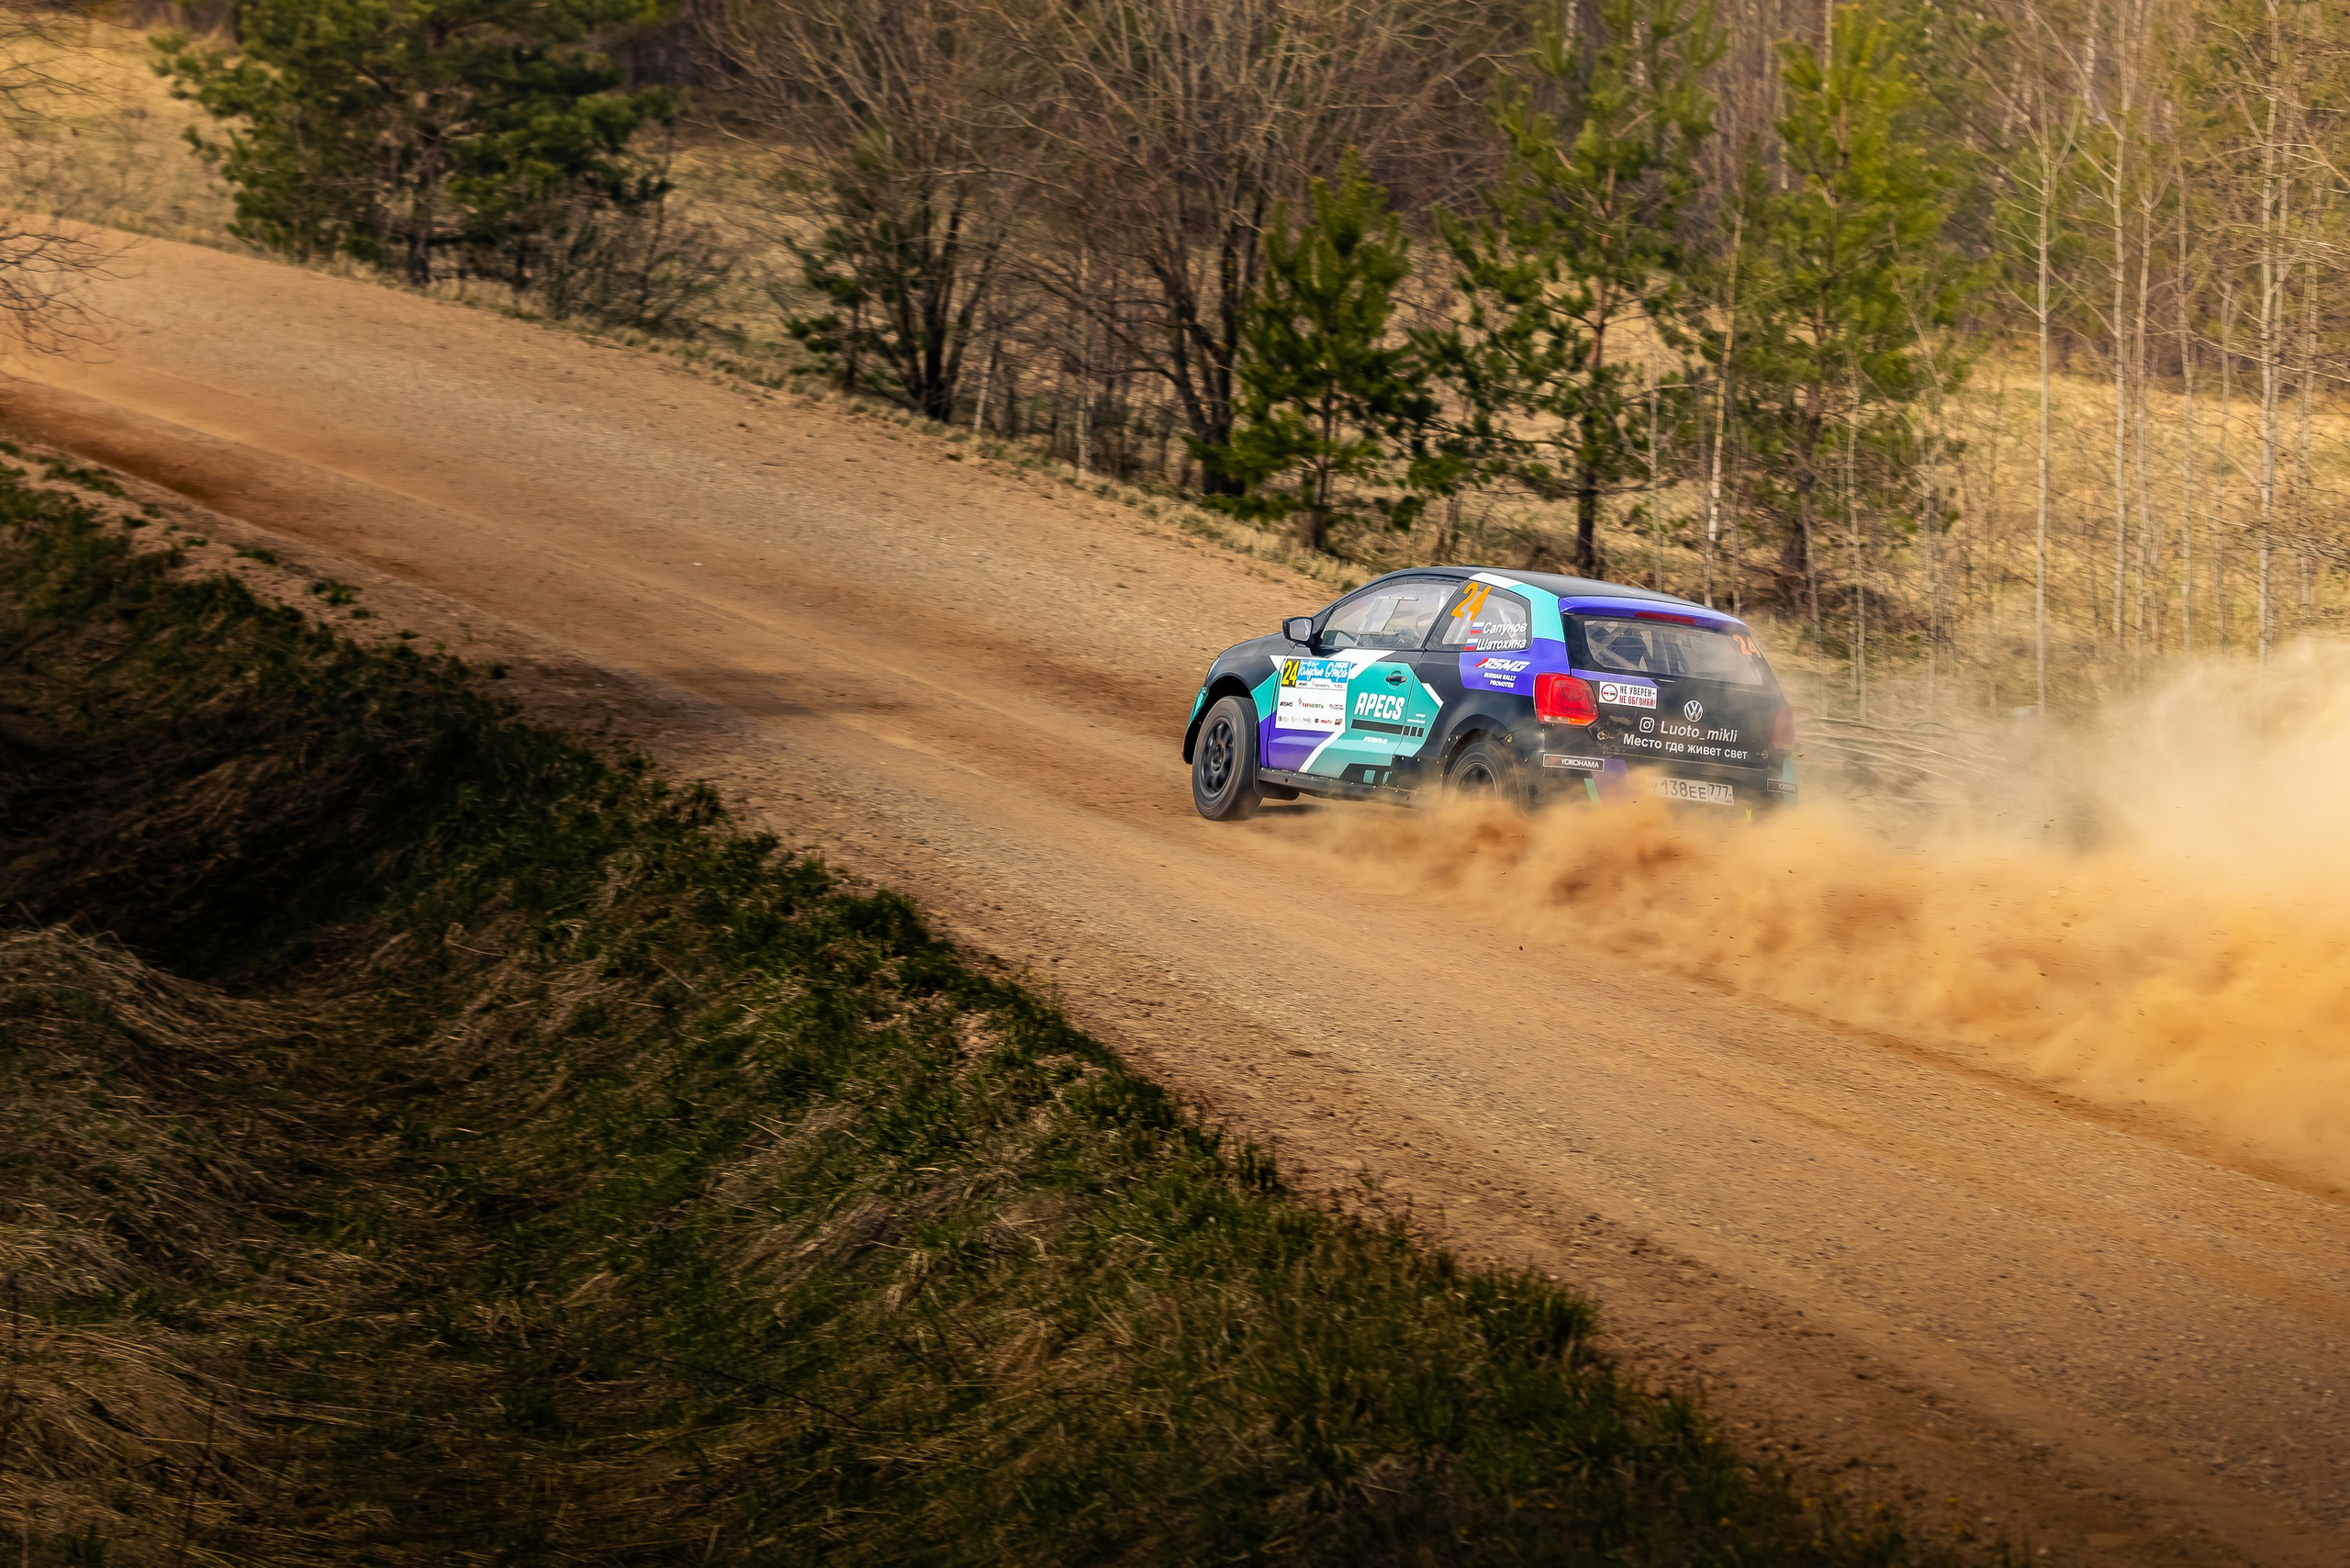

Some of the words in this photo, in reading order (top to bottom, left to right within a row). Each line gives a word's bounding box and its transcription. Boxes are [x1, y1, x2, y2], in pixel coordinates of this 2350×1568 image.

[1450, 581, 1493, 622] 24
[1483, 622, 1528, 636] Сапунов
[1476, 639, 1526, 651] Шатохина
[1731, 633, 1762, 659] 24
[1281, 660, 1299, 685] 24
[1502, 674, 1517, 682] RALLY
[1489, 679, 1515, 689] PROMOTER
[1619, 685, 1628, 695] НЕ
[1628, 687, 1656, 698] УВЕРЕН-
[1354, 692, 1406, 721] APECS
[1618, 695, 1627, 704] НЕ
[1628, 696, 1656, 708] ОБГОНЯЙ!
[1660, 720, 1739, 743] Luoto_mikli
[1623, 733, 1662, 749] Место
[1665, 741, 1684, 753] где
[1687, 743, 1722, 757] живет
[1724, 747, 1748, 760] свет
[1561, 757, 1600, 769] YOKOHAMA
[1708, 783, 1729, 799] 777
